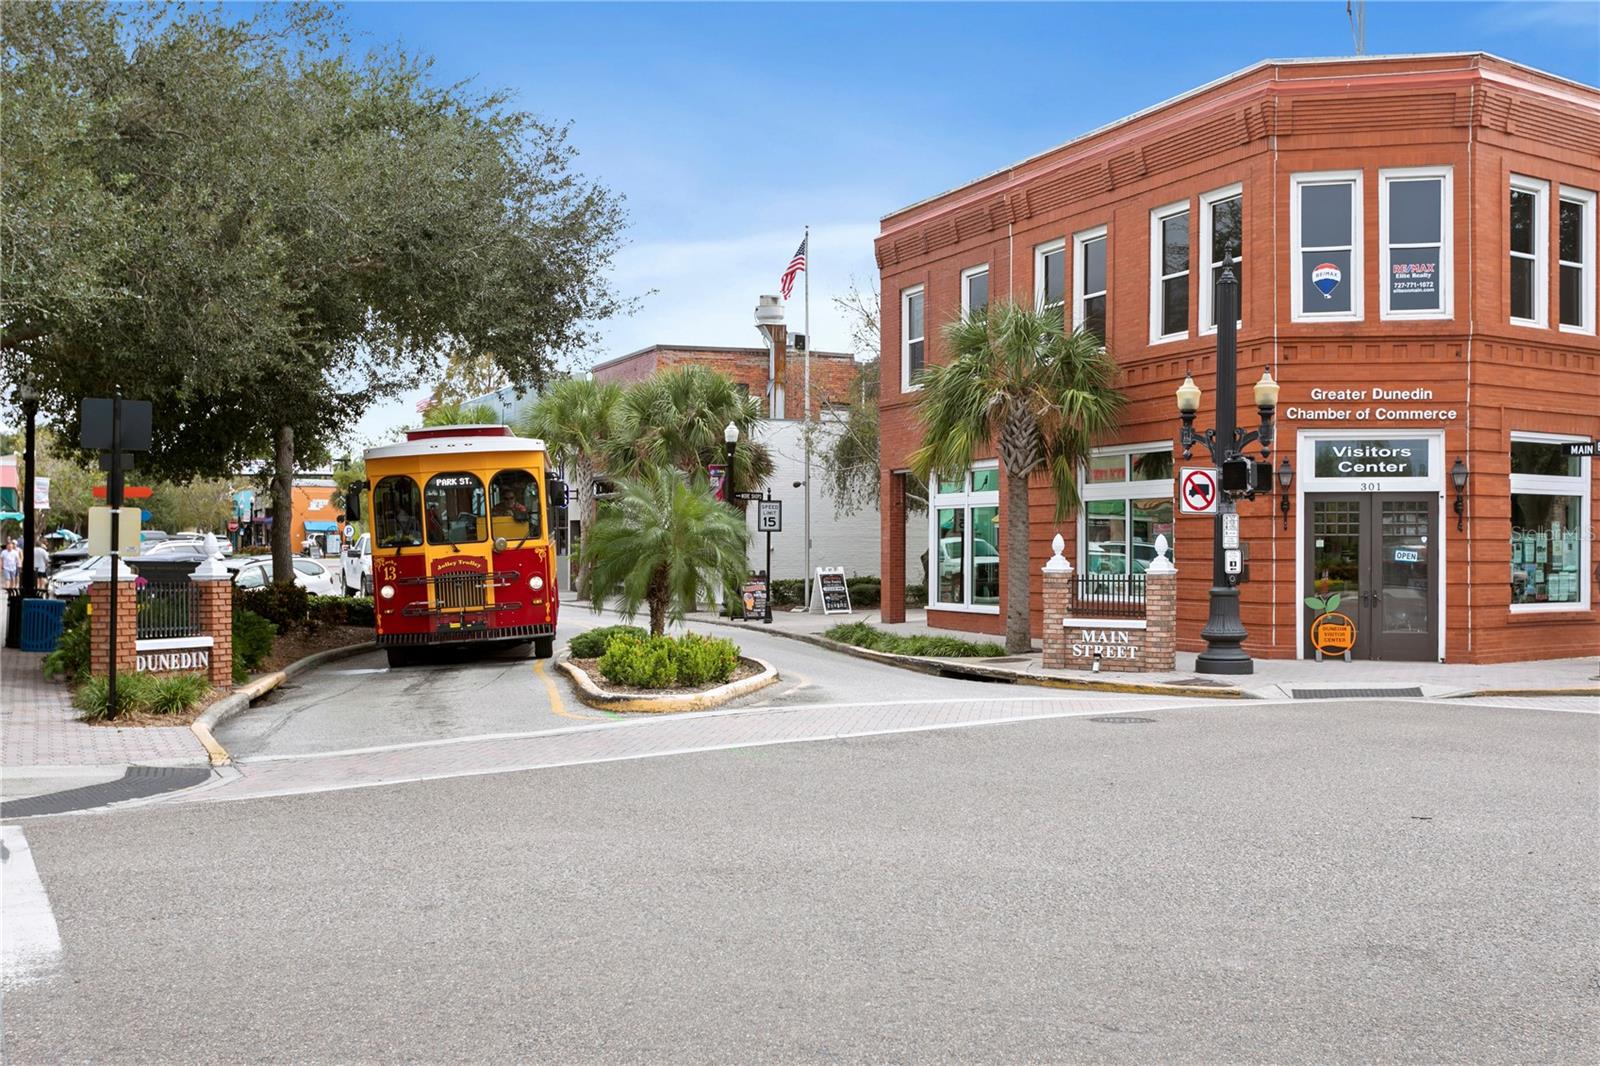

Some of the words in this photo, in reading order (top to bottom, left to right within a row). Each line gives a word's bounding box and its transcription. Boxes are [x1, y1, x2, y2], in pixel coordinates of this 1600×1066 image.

[1392, 263, 1435, 273] RE/MAX
[1311, 388, 1367, 400] Greater
[1372, 388, 1433, 400] Dunedin
[1286, 407, 1351, 420] Chamber
[1356, 408, 1370, 420] of
[1375, 408, 1457, 420] Commerce
[1332, 446, 1412, 457] Visitors
[1570, 445, 1594, 455] MAIN
[1338, 461, 1407, 473] Center
[436, 478, 458, 487] PARK
[458, 478, 472, 486] ST.
[1360, 483, 1381, 491] 301
[763, 516, 776, 527] 15
[1396, 551, 1416, 560] OPEN
[383, 566, 397, 580] 13
[1081, 630, 1129, 643] MAIN
[1072, 644, 1138, 659] STREET
[136, 651, 209, 672] DUNEDIN
